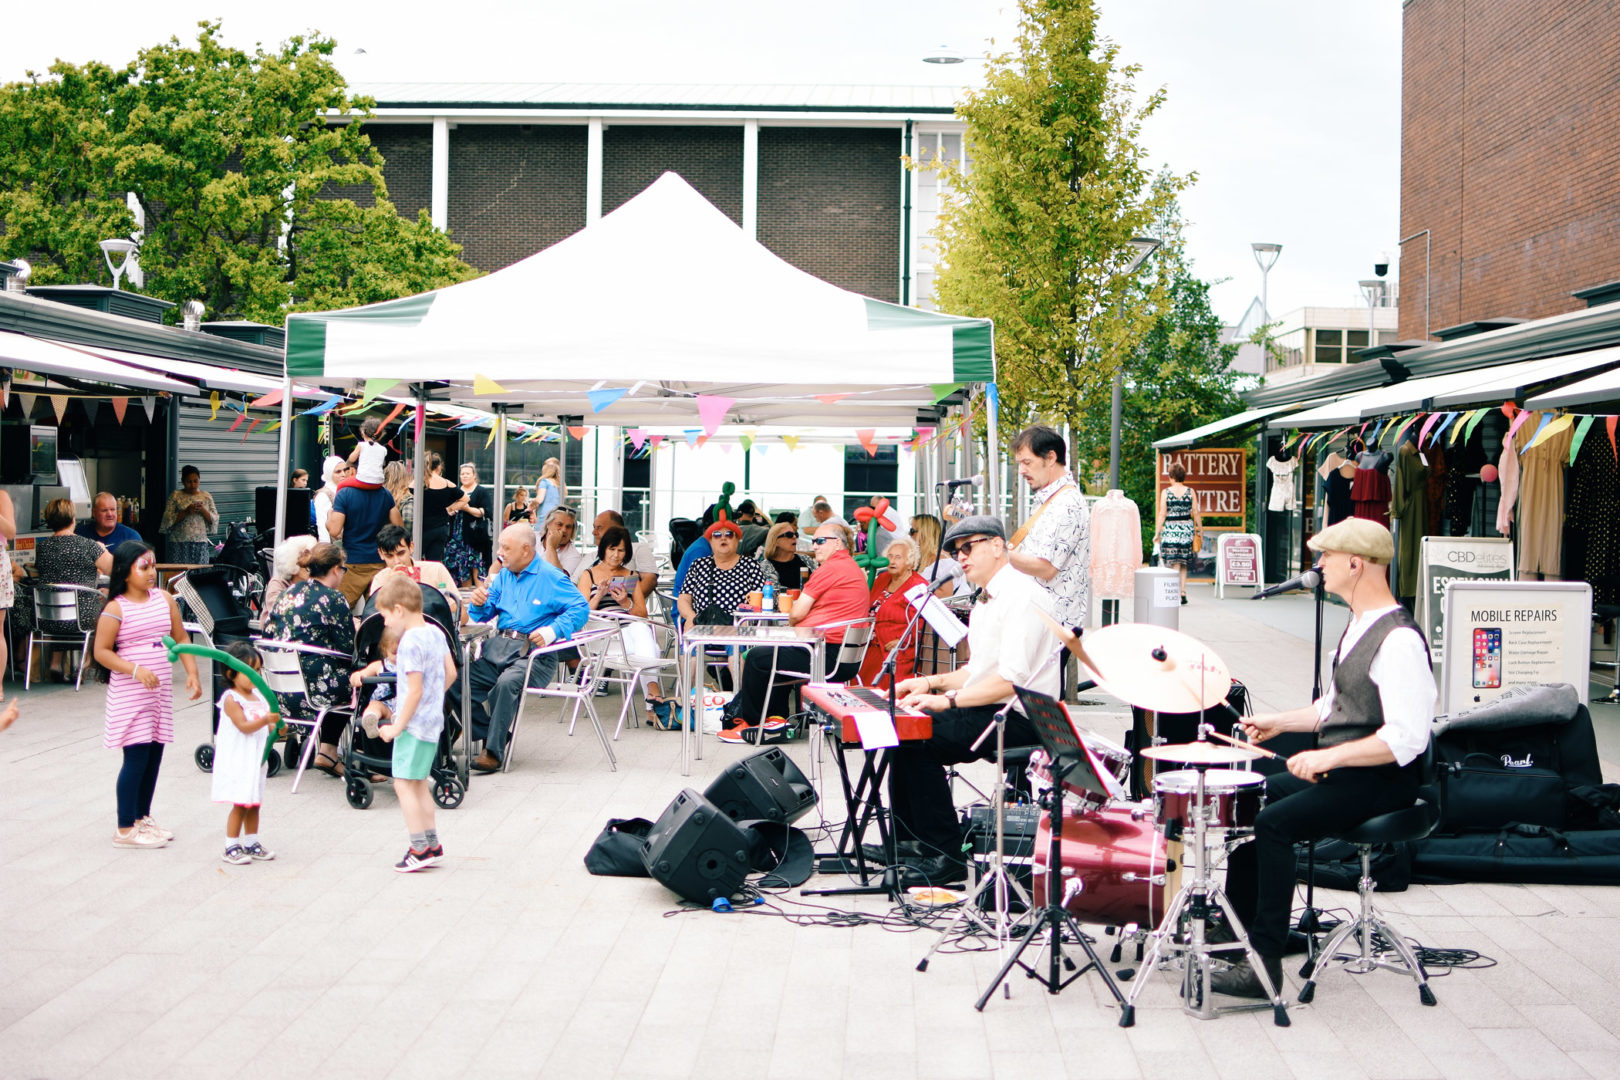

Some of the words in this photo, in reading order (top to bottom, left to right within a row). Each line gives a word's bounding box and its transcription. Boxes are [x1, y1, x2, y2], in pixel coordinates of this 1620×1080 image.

[1471, 610, 1511, 622] MOBILE
[1514, 609, 1557, 621] REPAIRS
[1500, 753, 1533, 767] Pearl
